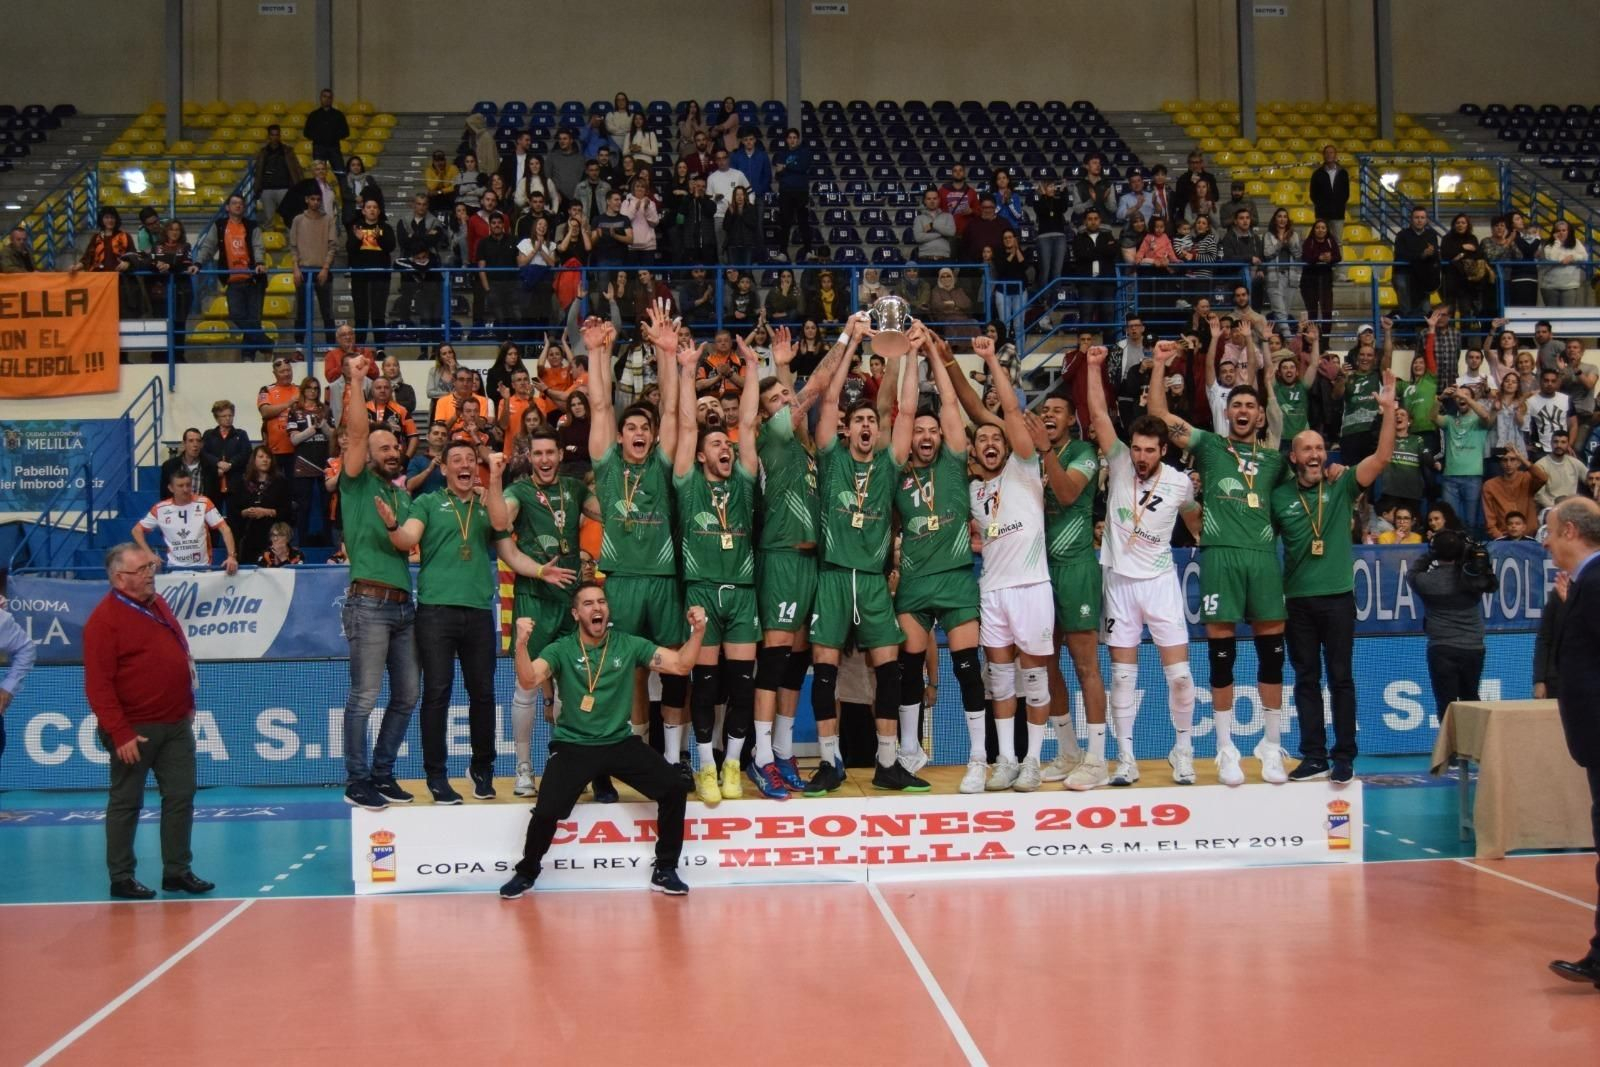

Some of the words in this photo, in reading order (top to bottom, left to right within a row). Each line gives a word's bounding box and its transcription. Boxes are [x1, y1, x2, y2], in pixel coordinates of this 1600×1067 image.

[0, 329, 27, 351] ON
[39, 329, 66, 349] EL
[26, 438, 84, 450] MELILLA
[14, 464, 69, 477] Pabellón
[910, 481, 935, 508] 10
[1138, 489, 1164, 512] 12
[178, 510, 187, 524] 4
[998, 520, 1024, 536] nicaja
[1133, 525, 1161, 544] Unicaja
[8, 596, 70, 612] ÓNOMA
[778, 601, 798, 618] 14
[1203, 593, 1219, 612] 15
[188, 620, 257, 637] DEPORTE
[24, 711, 230, 765] COA
[551, 809, 1017, 845] CAMPEONES
[1035, 803, 1191, 832] 2019
[718, 841, 1015, 869] MELILLA
[1026, 844, 1093, 857] COPA
[1100, 842, 1148, 854] S.M.
[1157, 840, 1188, 851] EL
[1195, 837, 1241, 850] REY
[1249, 835, 1304, 848] 2019
[416, 861, 486, 875] COPA
[554, 858, 585, 870] EL
[593, 856, 641, 869] REY
